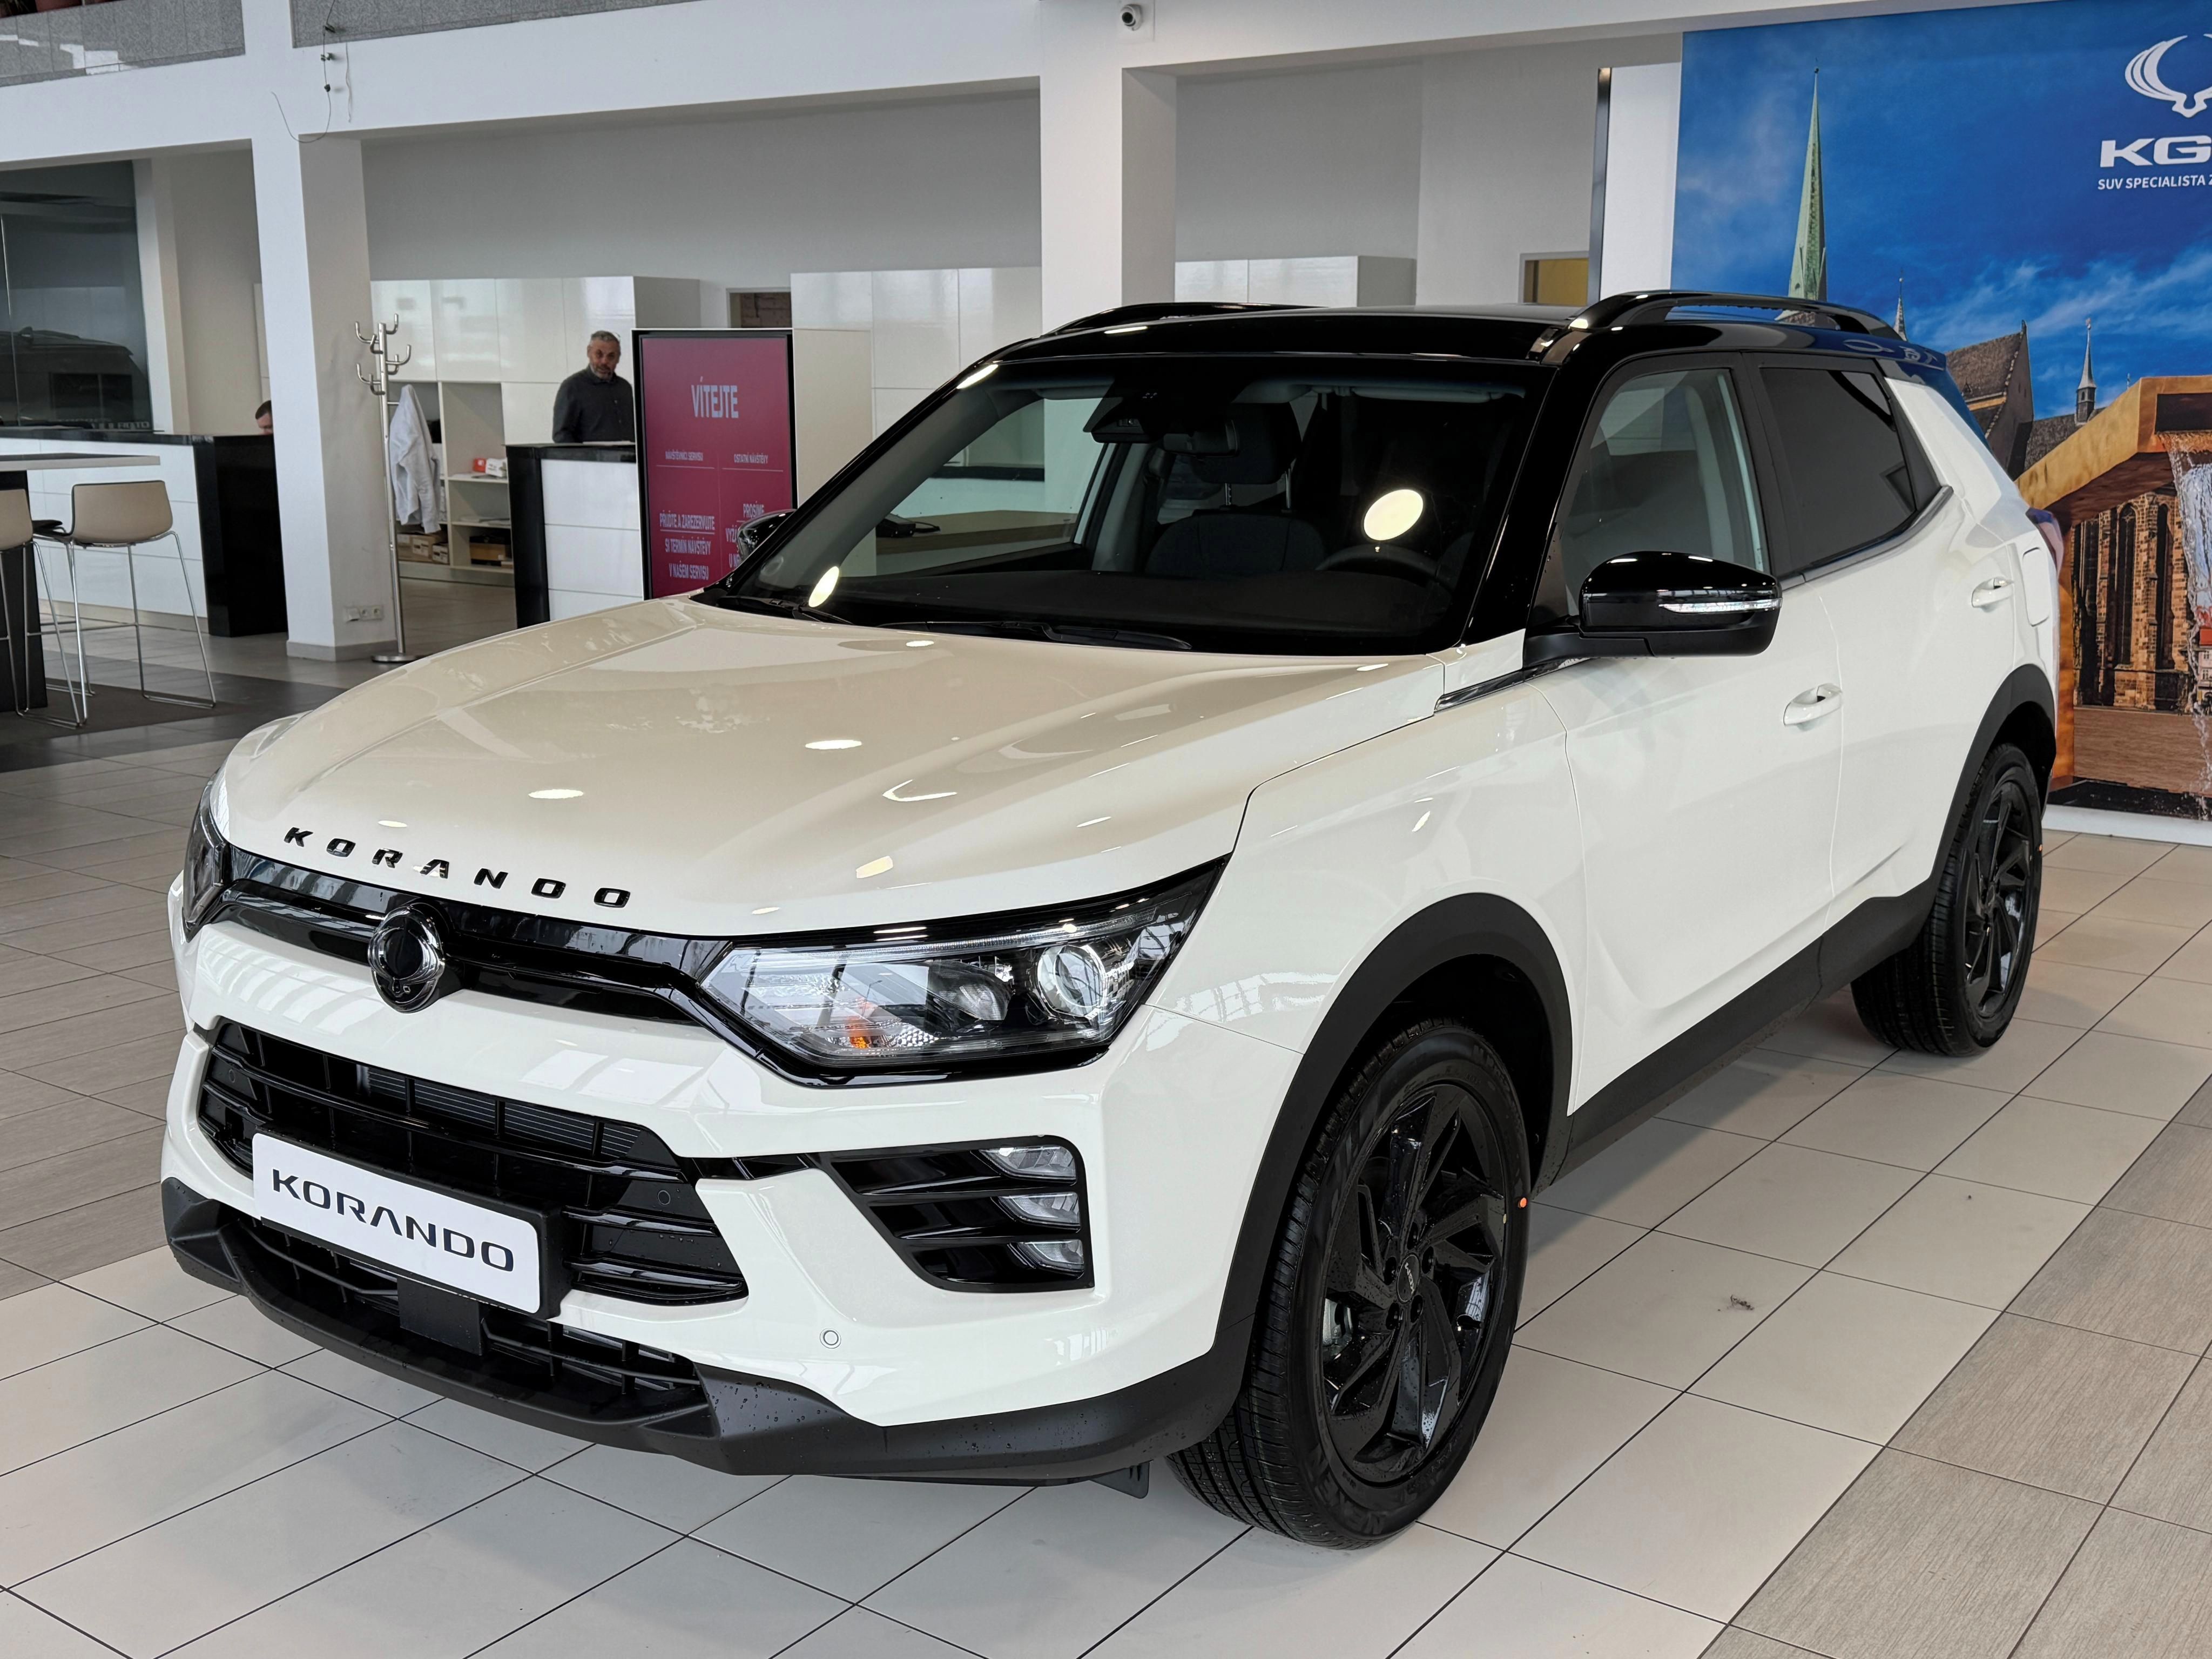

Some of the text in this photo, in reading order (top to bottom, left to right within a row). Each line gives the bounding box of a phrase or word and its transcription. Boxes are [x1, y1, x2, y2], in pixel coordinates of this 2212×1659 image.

[2098, 179, 2123, 190] SUV
[2126, 174, 2206, 188] SPECIALISTA
[691, 376, 739, 418] VÍTEJTE
[665, 538, 670, 552] SI
[669, 563, 673, 577] V
[284, 827, 631, 908] KORANDO
[272, 1169, 514, 1272] KORANDO
